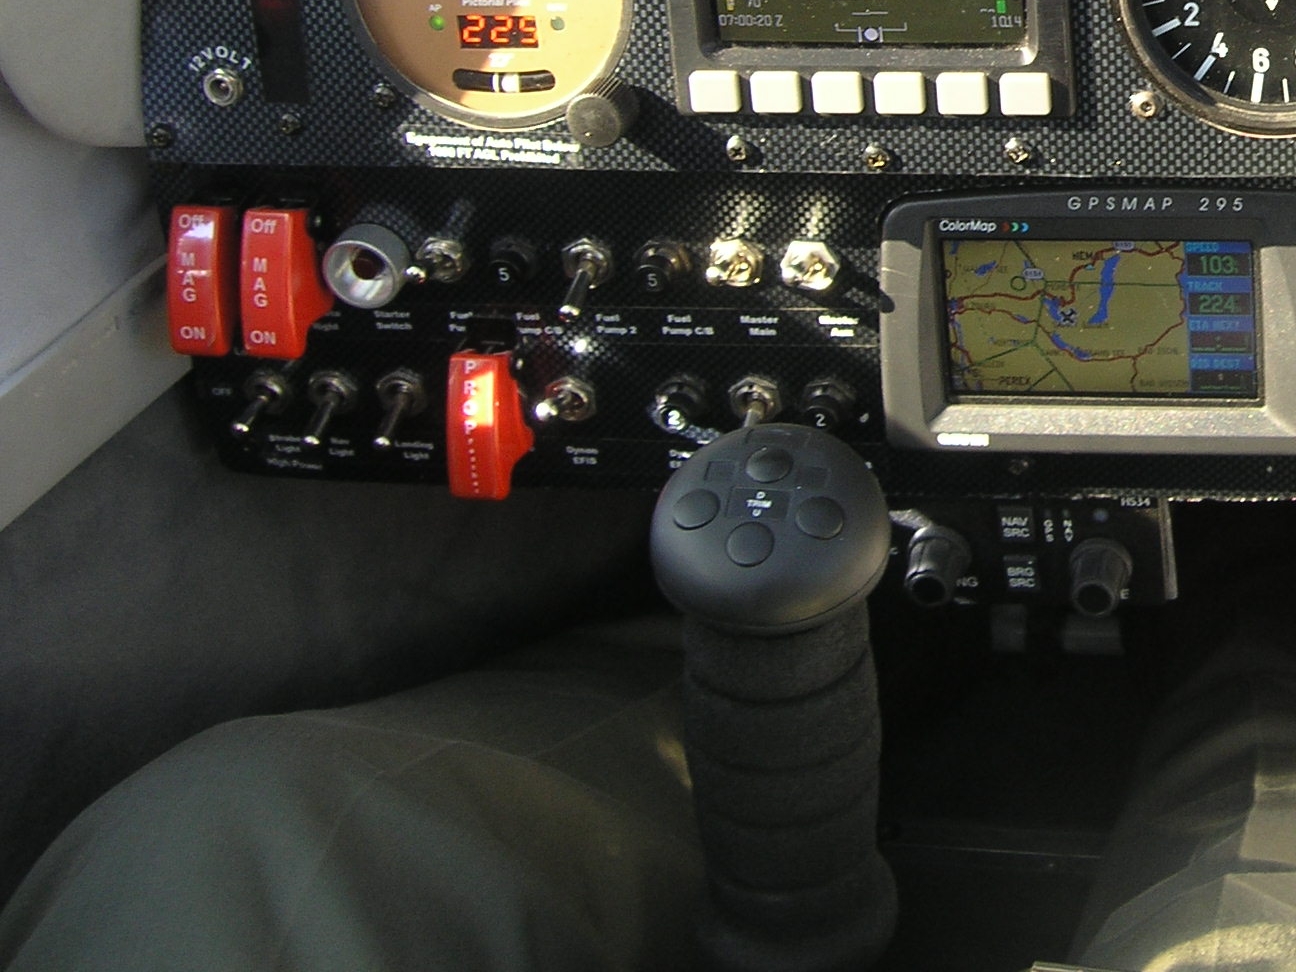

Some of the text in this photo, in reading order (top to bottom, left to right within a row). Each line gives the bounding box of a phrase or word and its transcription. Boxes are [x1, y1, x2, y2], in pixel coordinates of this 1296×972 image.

[462, 14, 539, 44] 225
[188, 45, 251, 72] 12VOLT
[1068, 197, 1245, 212] GPSMAP 295
[178, 214, 204, 228] Off
[250, 218, 277, 234] Off
[939, 220, 997, 232] ColorMap
[1201, 256, 1235, 274] 103
[1189, 281, 1223, 291] TRACK
[1200, 296, 1236, 313] 224
[739, 315, 779, 324] Master
[180, 327, 205, 339] ON
[749, 327, 777, 336] Main
[250, 331, 277, 345] ON
[746, 498, 772, 509] TRIM
[1001, 517, 1028, 526] NAV
[1003, 528, 1030, 537] SRC
[1009, 578, 1035, 587] SRC
